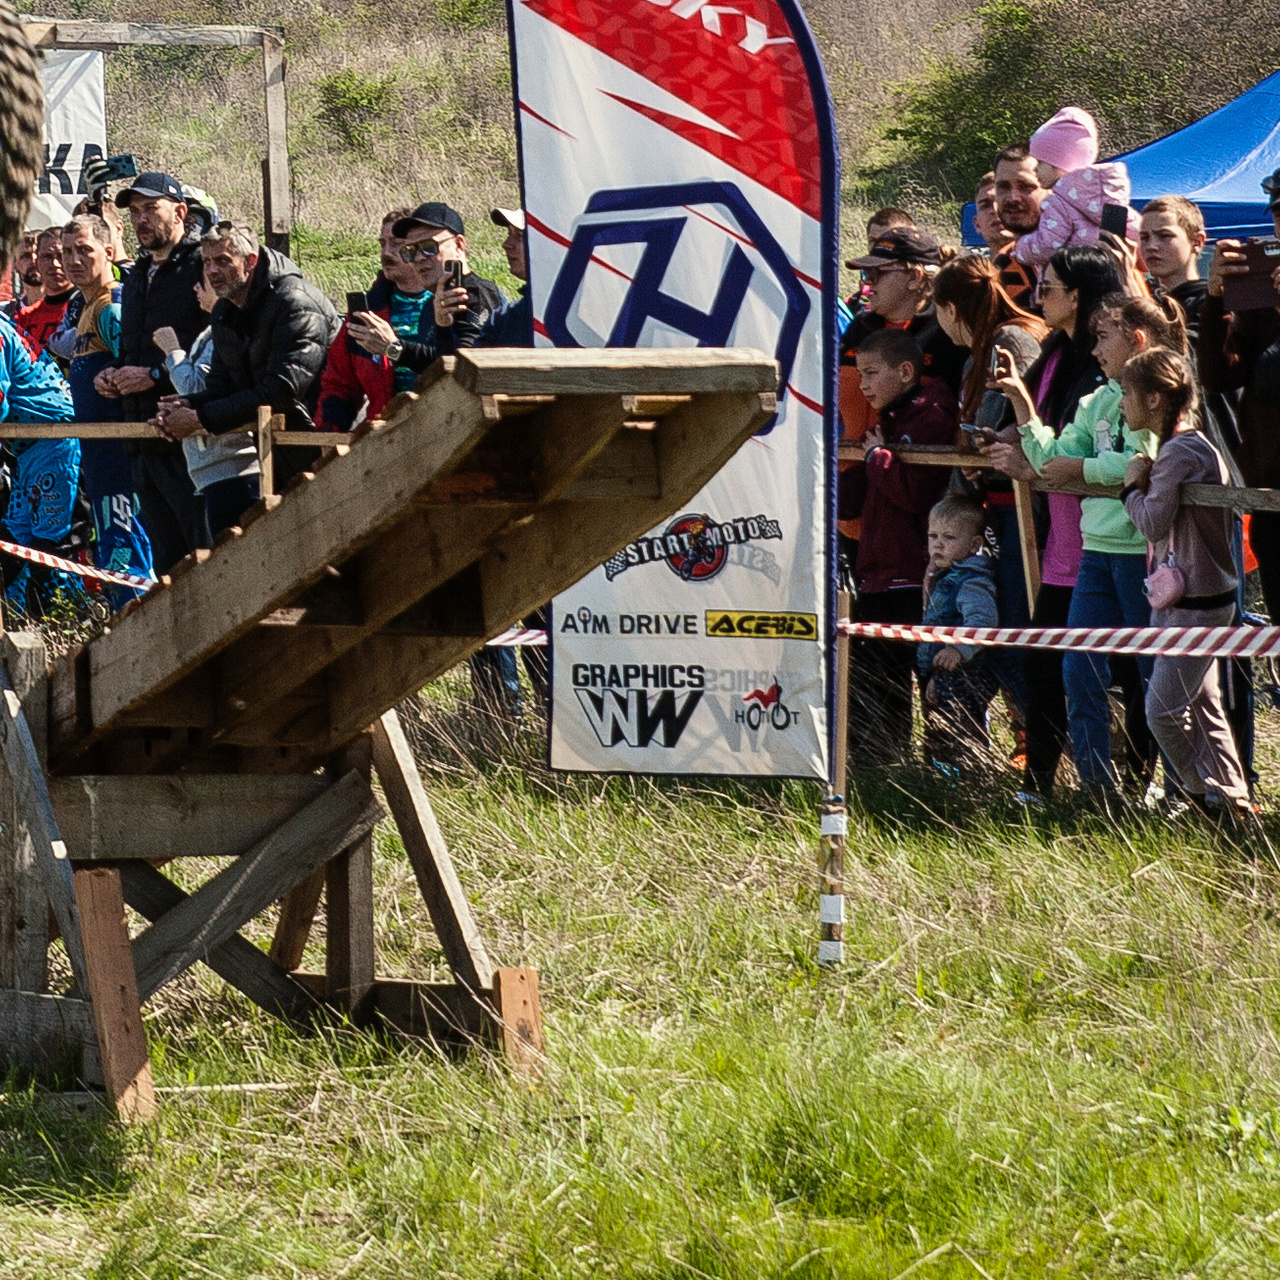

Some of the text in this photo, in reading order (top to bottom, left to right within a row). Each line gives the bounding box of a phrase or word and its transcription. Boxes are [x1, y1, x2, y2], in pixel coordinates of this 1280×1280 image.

[625, 520, 760, 564] START MOTO
[620, 614, 698, 635] DRIVE
[572, 664, 705, 689] GRAPHICS
